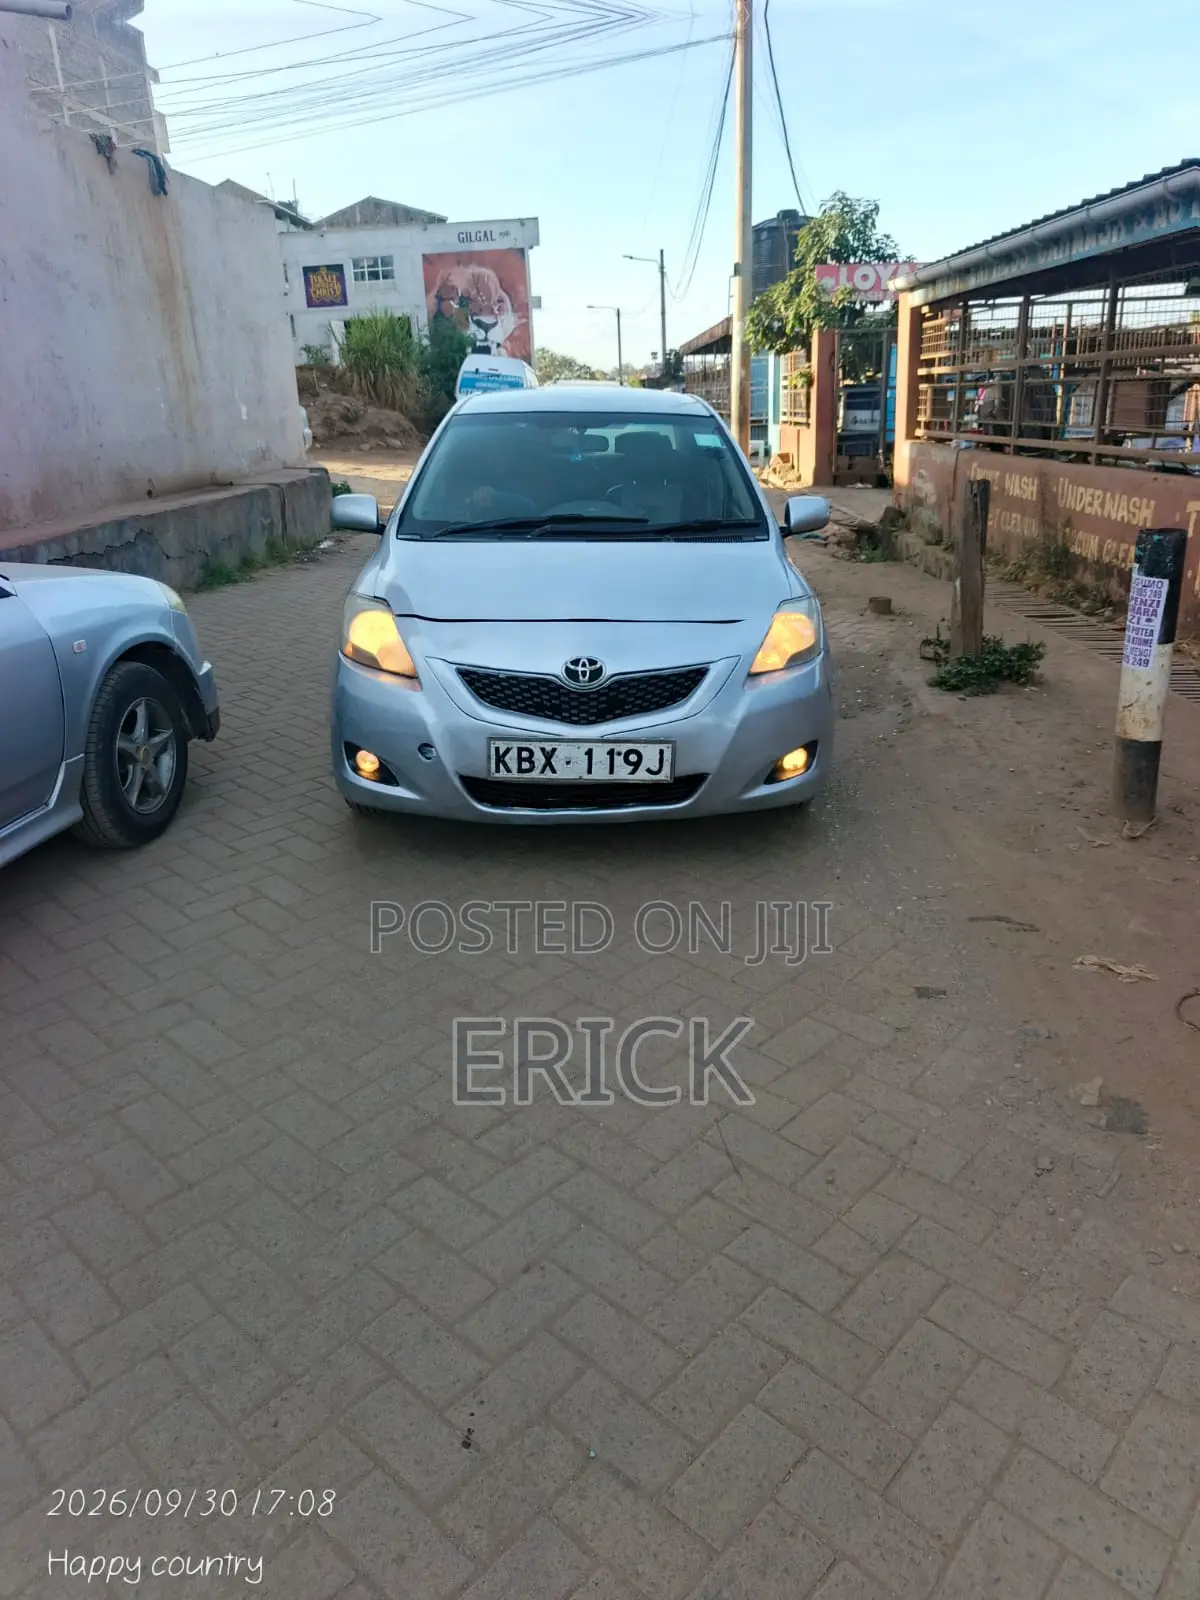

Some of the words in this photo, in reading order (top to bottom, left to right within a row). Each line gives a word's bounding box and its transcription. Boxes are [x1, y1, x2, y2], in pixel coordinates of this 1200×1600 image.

[457, 229, 496, 244] GILGAL
[1005, 471, 1038, 502] WASH
[1131, 656, 1150, 668] 249
[494, 746, 558, 775] KBX
[584, 747, 665, 776] 119J
